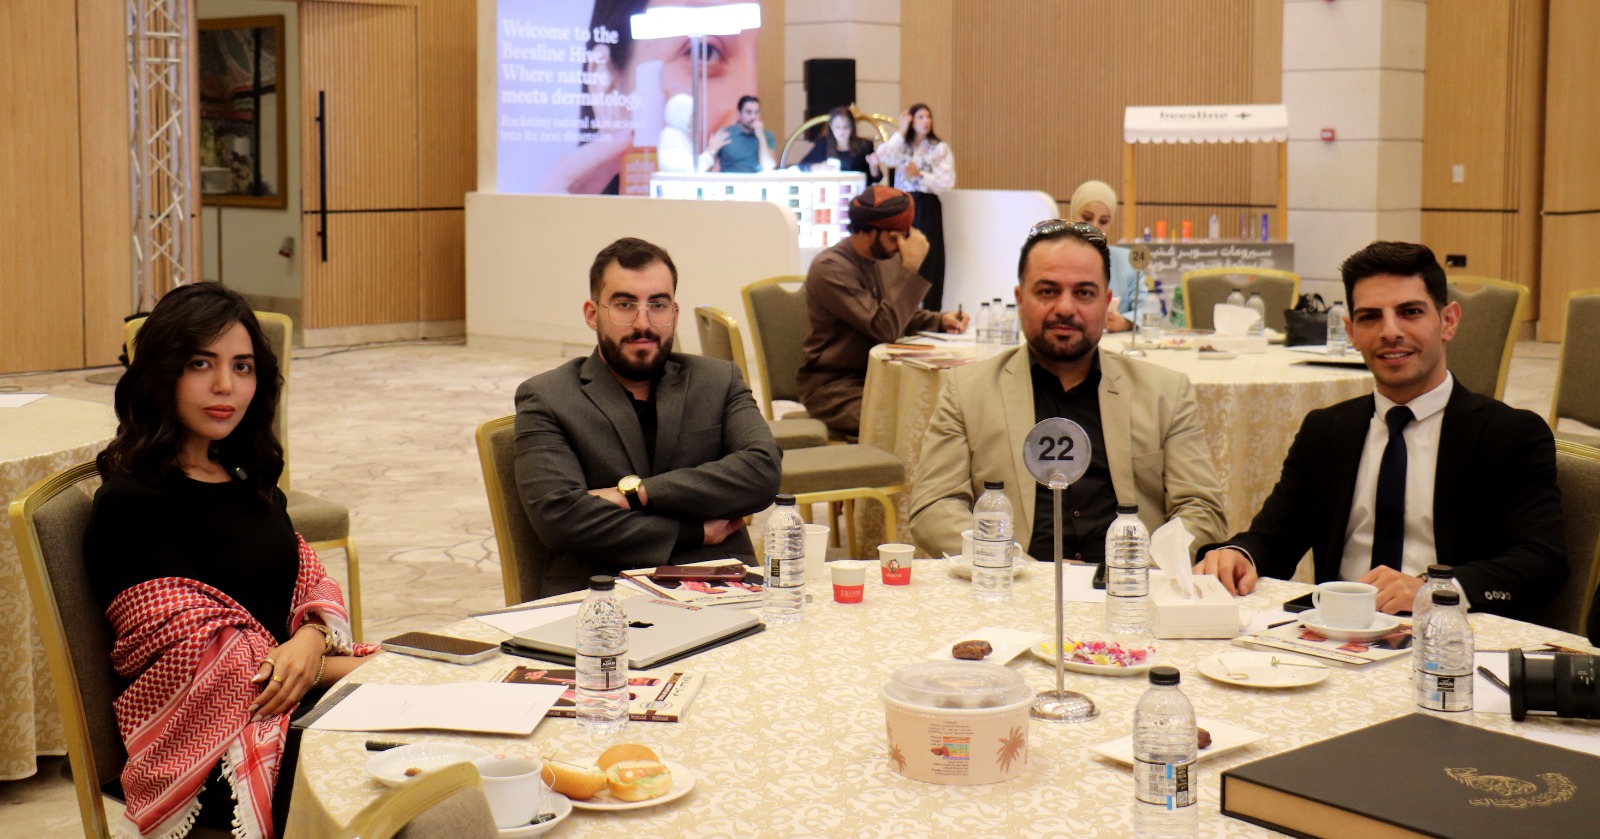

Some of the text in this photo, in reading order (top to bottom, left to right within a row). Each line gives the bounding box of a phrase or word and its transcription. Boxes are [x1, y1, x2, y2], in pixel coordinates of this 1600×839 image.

[502, 19, 619, 44] Welcome to the
[502, 41, 566, 62] Beesline
[502, 63, 610, 86] Where nature
[502, 89, 548, 105] meets
[1132, 252, 1145, 261] 24
[1038, 435, 1074, 461] 22
